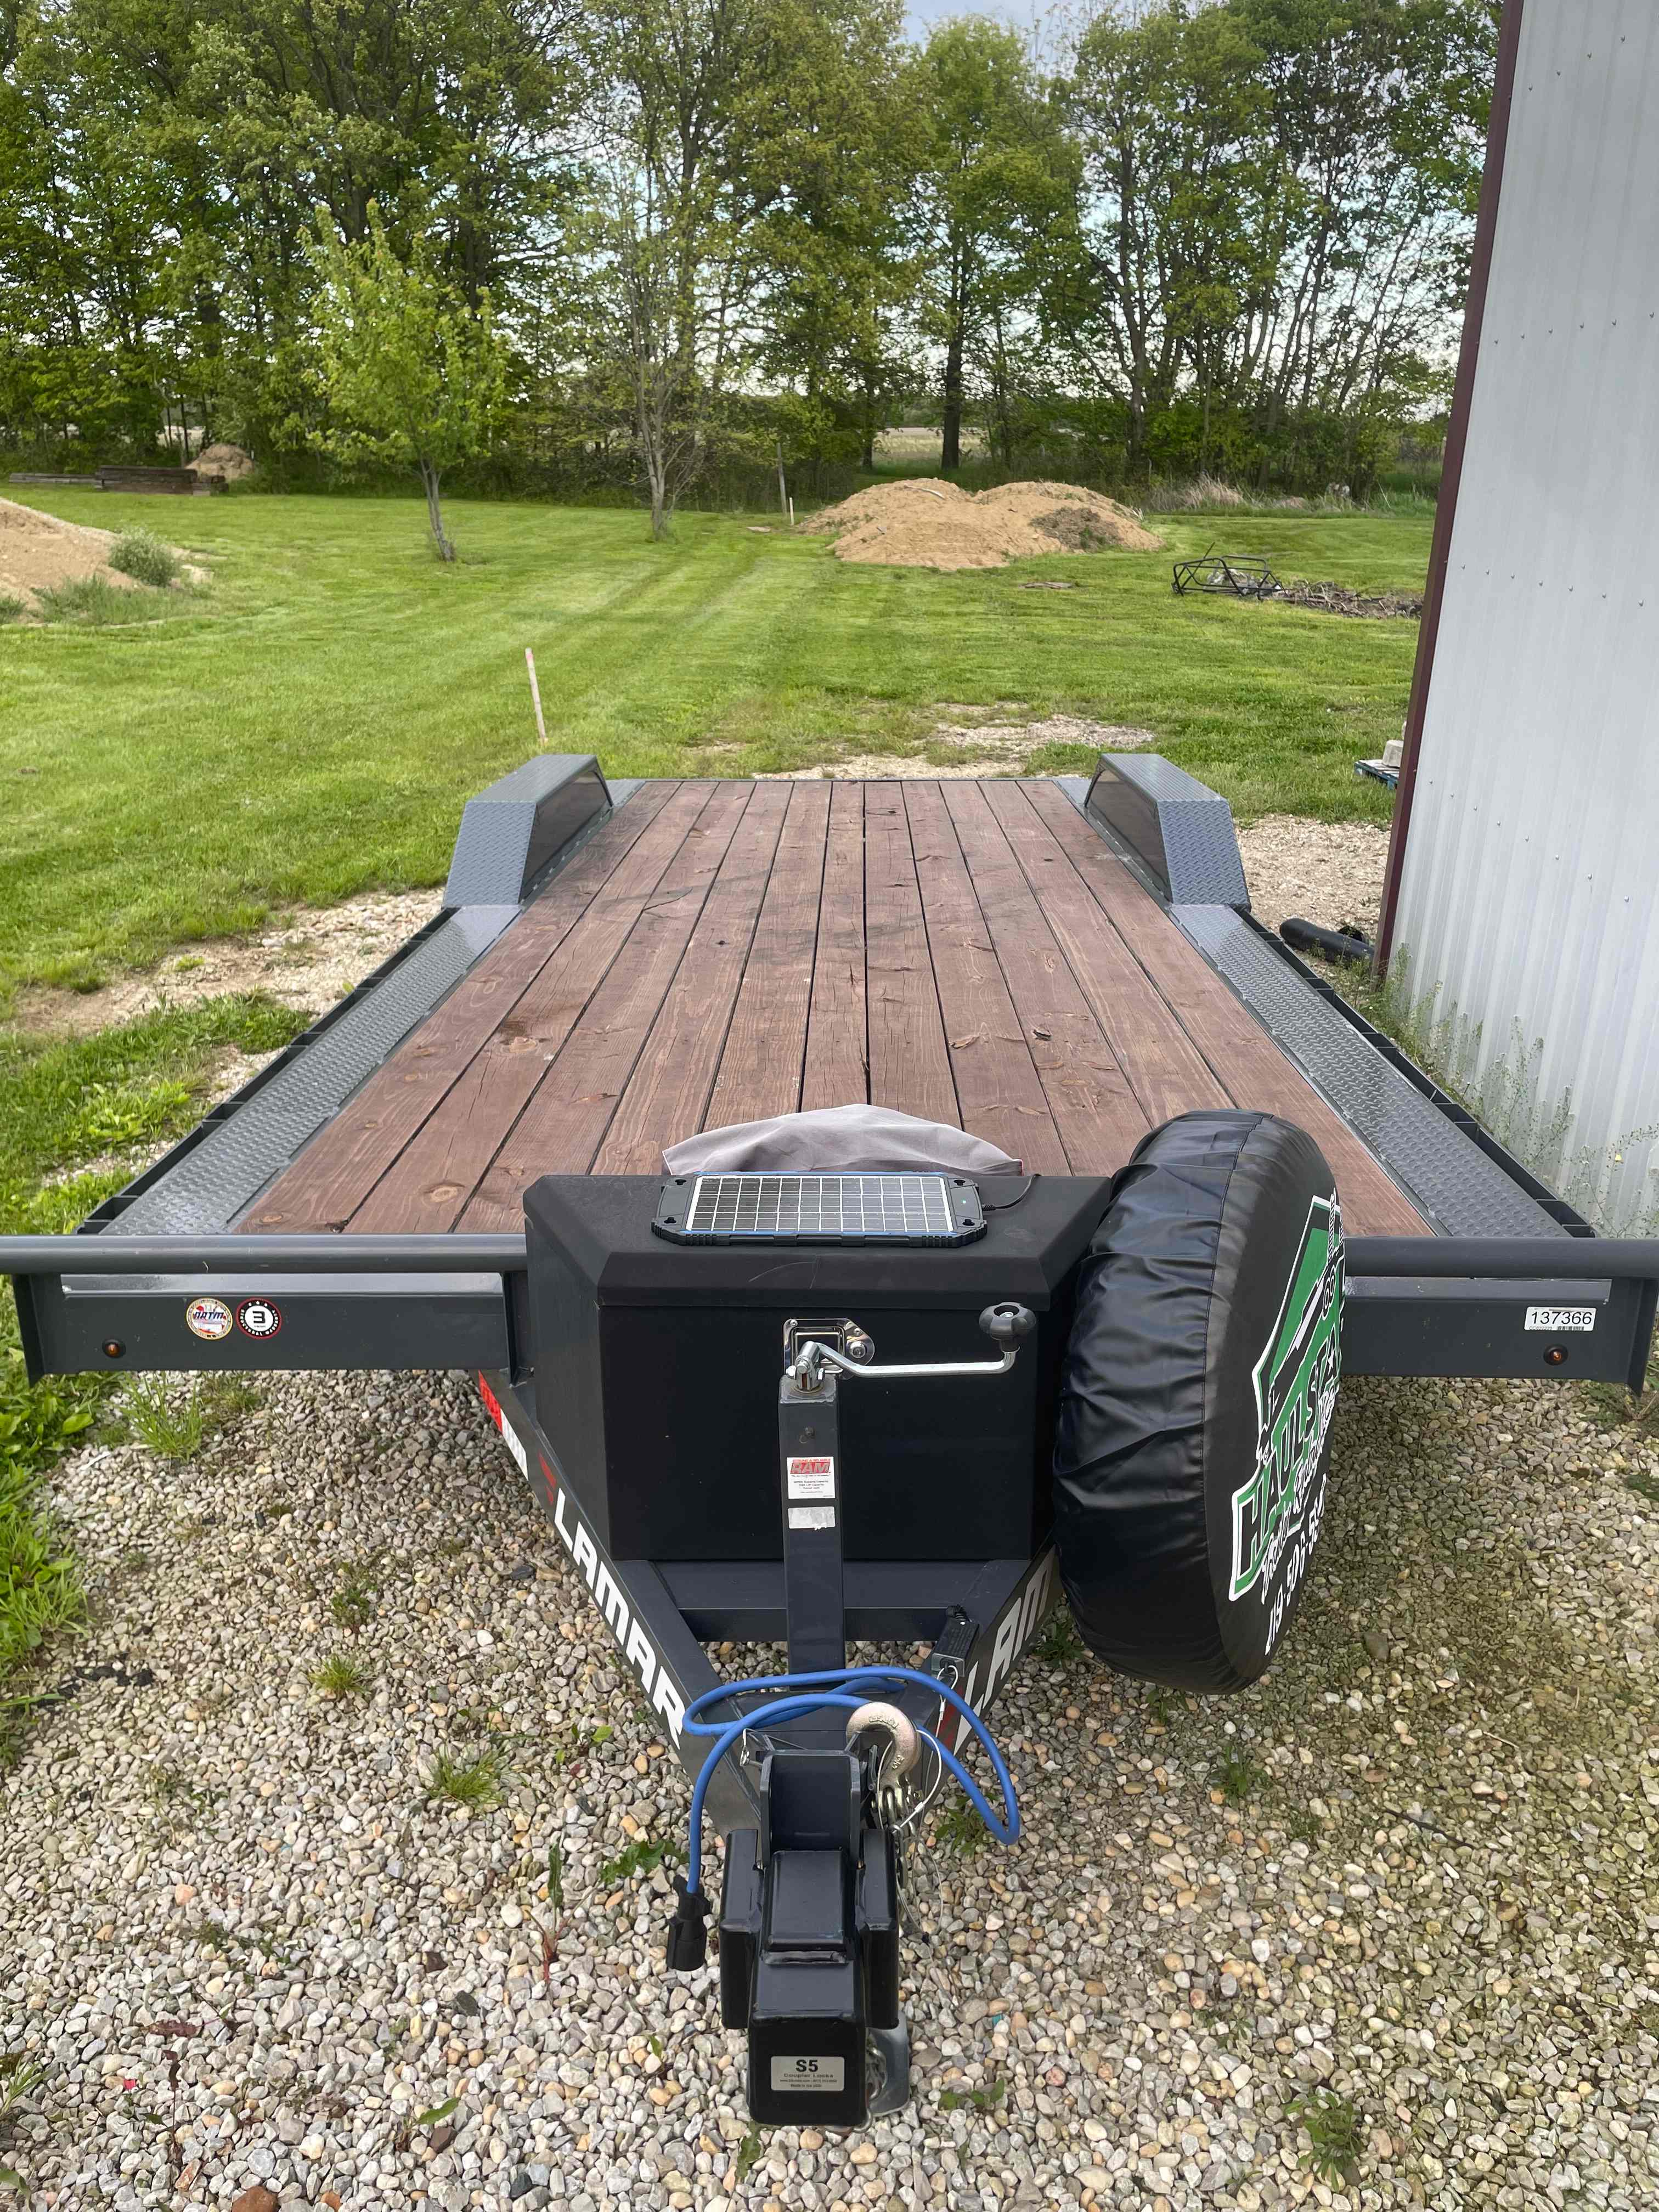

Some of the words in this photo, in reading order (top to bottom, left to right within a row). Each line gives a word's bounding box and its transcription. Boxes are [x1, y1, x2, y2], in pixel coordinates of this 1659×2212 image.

[252, 1311, 266, 1324] 3
[1531, 1312, 1592, 1324] 137366
[791, 1462, 830, 1474] RAM
[554, 1487, 687, 1750] LAMAR
[953, 1543, 1057, 1757] LAM
[795, 2059, 819, 2072] S5
